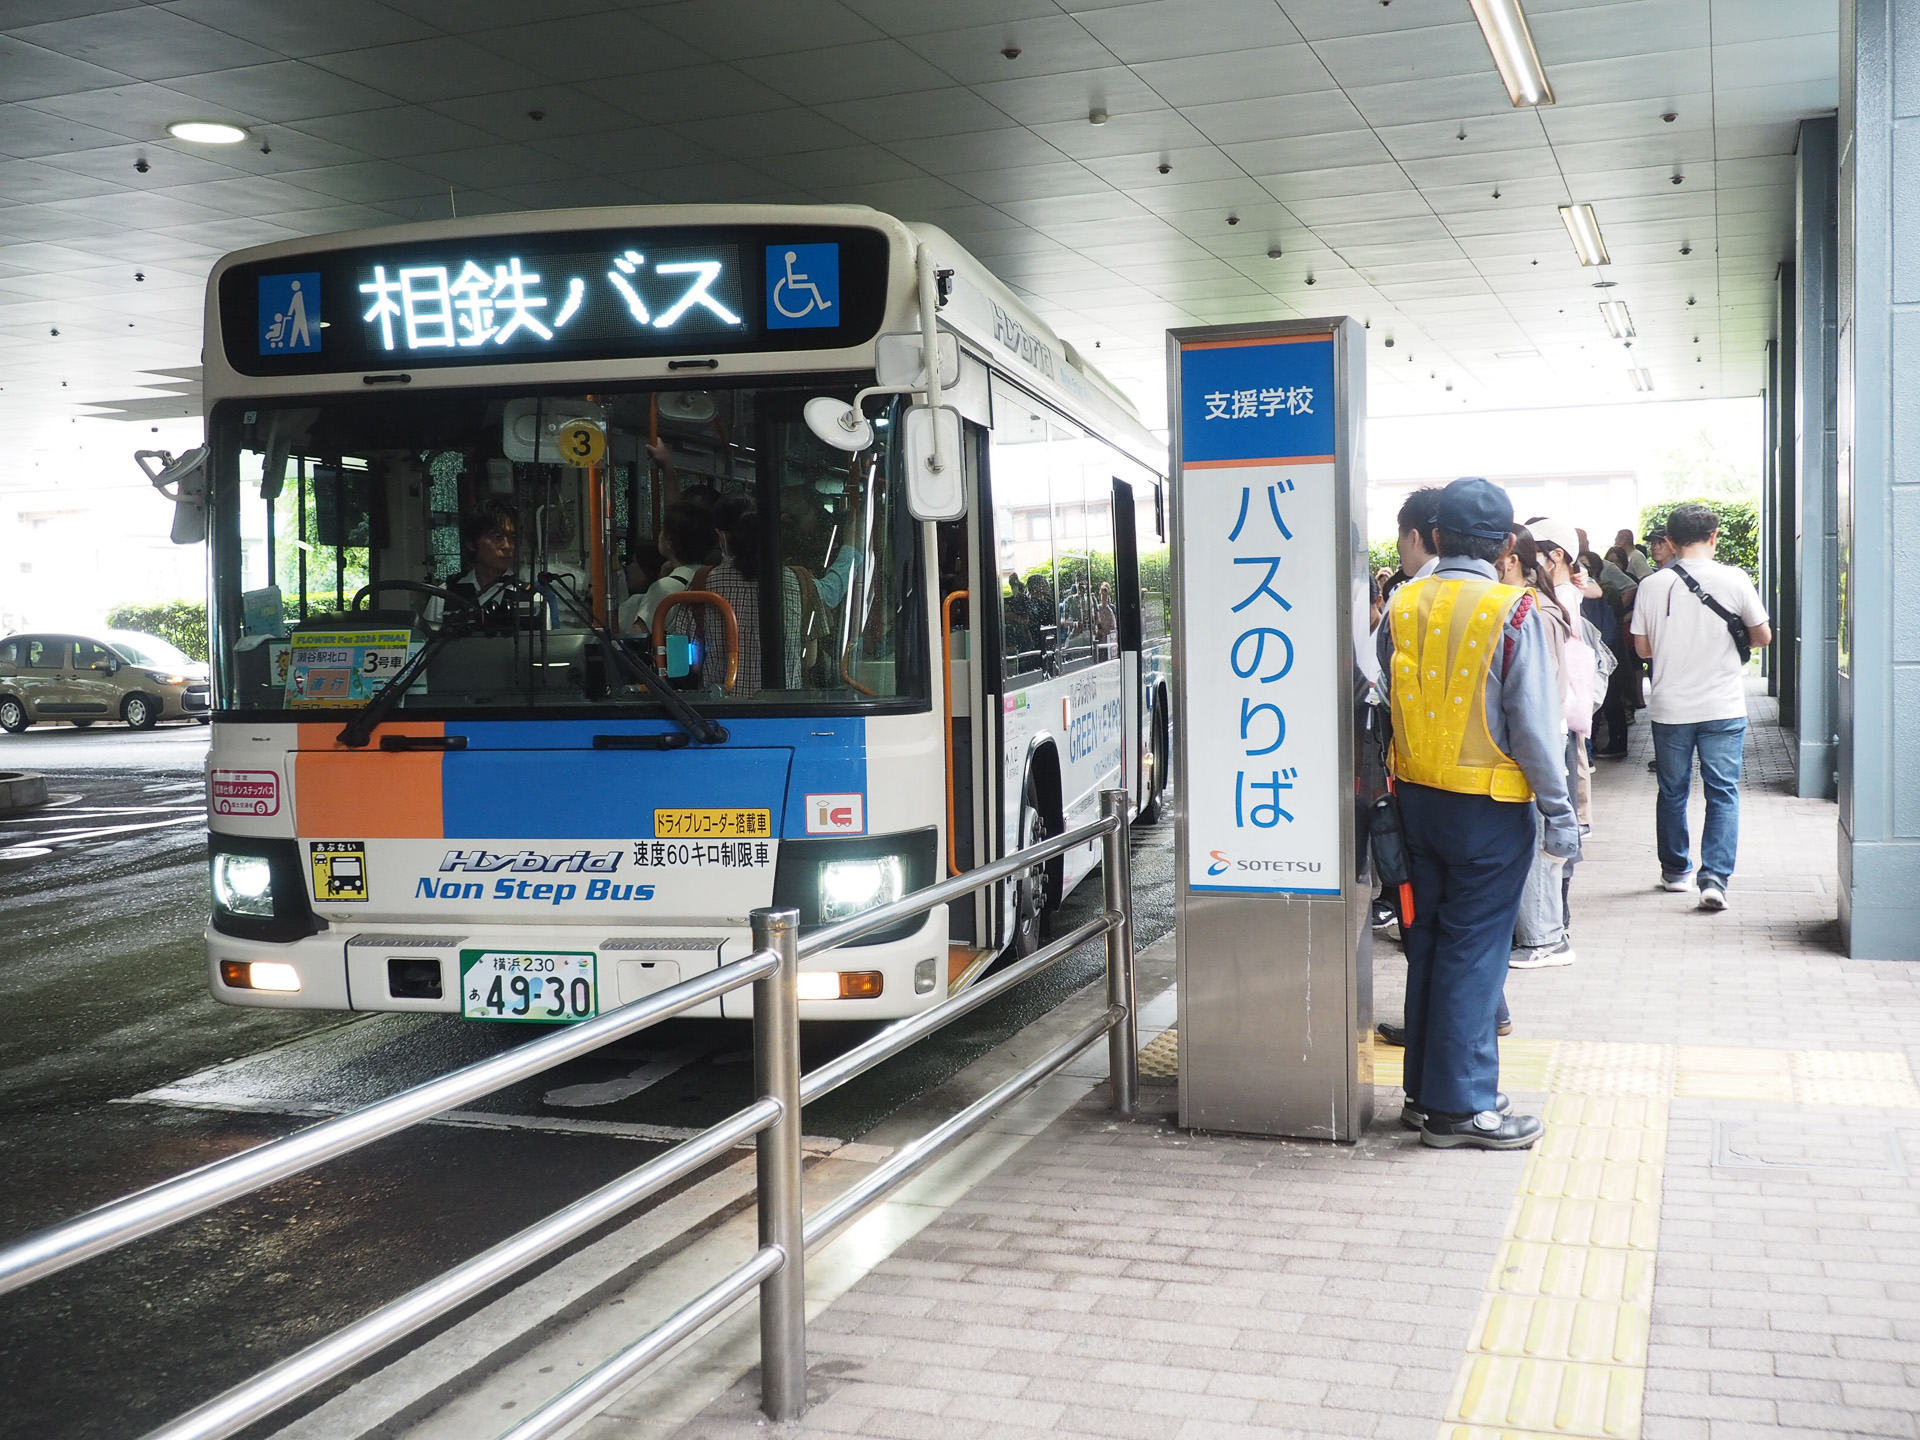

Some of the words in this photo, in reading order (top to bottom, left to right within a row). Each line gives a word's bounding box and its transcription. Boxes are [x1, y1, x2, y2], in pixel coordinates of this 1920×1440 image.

[359, 251, 741, 350] 相鉄バス
[1204, 385, 1314, 420] 支援学校
[573, 430, 591, 456] 3
[297, 635, 336, 644] FLOWER
[355, 634, 377, 643] 2026
[378, 633, 406, 642] FINAL
[297, 651, 347, 663] 瀬谷駅北口
[364, 652, 402, 673] 3号車
[1228, 479, 1298, 829] バスのりば
[311, 677, 346, 690] 直行
[657, 813, 767, 834] ドライブレコーダー搭載車
[316, 843, 356, 852] あぶない
[633, 841, 770, 867] 速度60キロ制限車
[439, 851, 624, 872] Hybrid
[1237, 860, 1321, 873] SOTETSU
[415, 877, 484, 900] Non
[493, 878, 576, 905] Step
[585, 879, 656, 901] Bus
[469, 988, 481, 1001] あ
[486, 975, 590, 1017] 49-30
